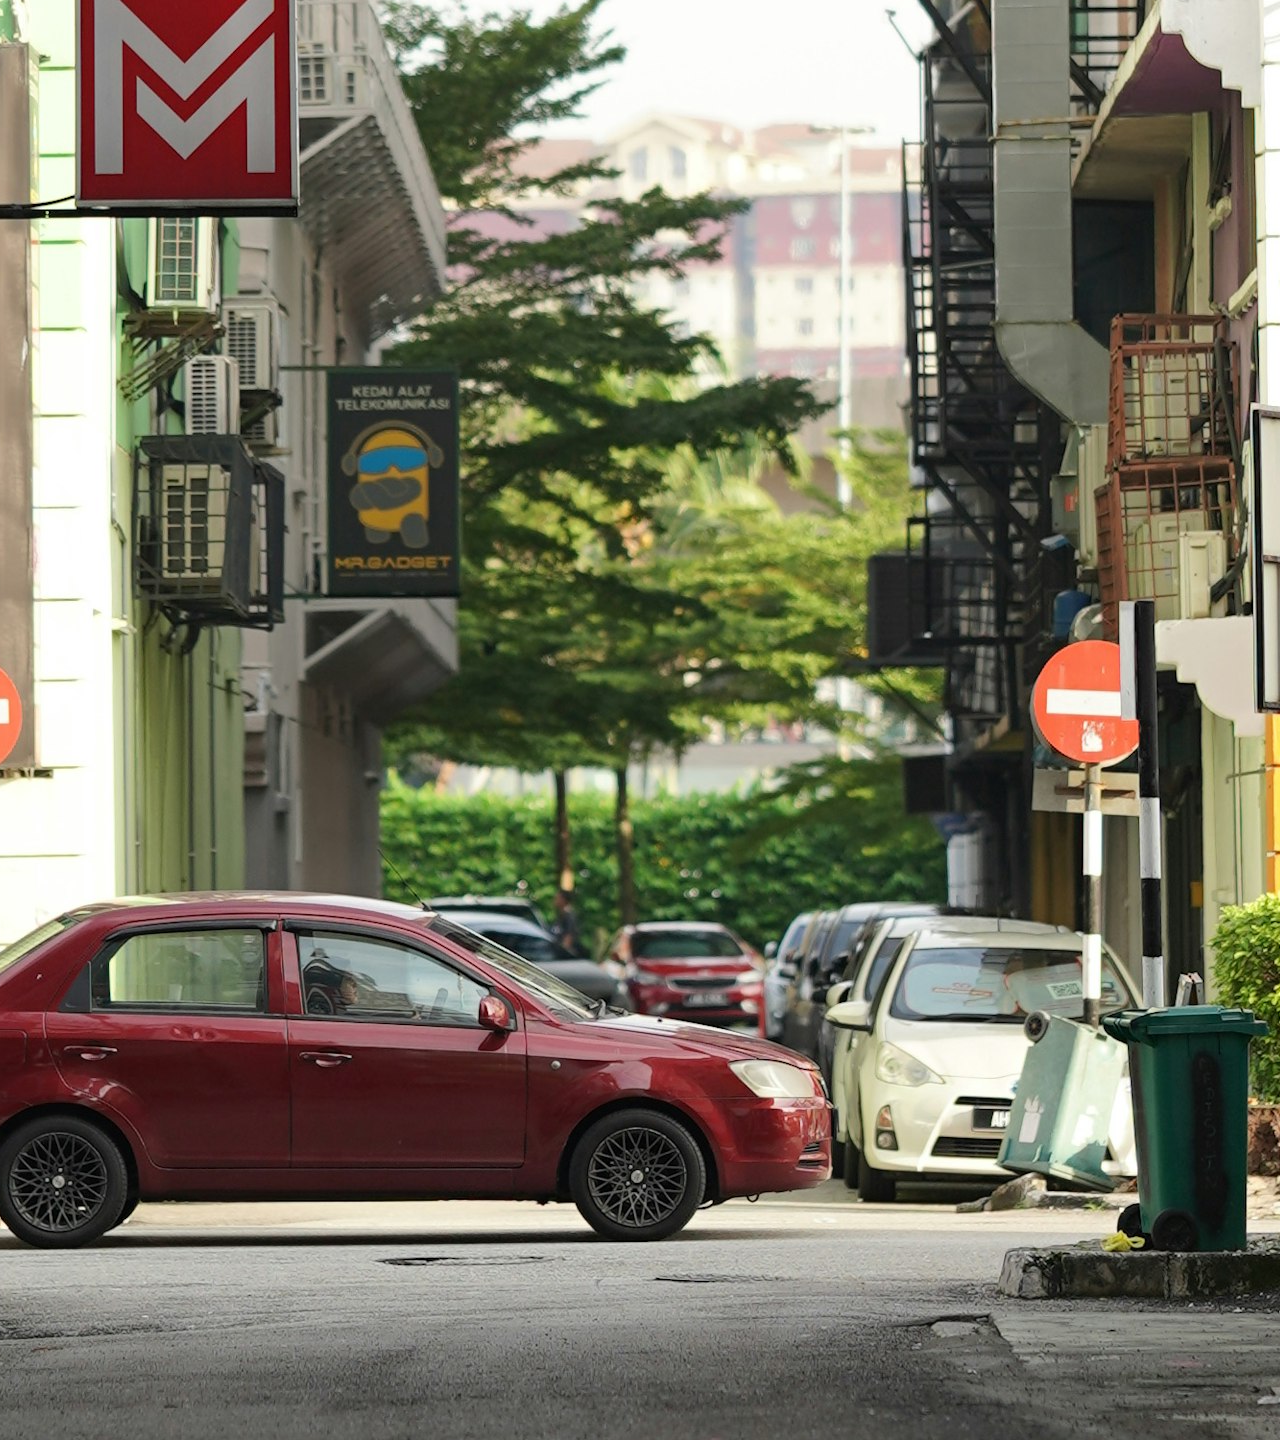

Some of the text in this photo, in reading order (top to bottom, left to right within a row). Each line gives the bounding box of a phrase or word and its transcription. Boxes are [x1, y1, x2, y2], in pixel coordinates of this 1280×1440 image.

[352, 385, 432, 397] KEDAI ALAT
[335, 398, 451, 411] TELEKOMUNIKASI
